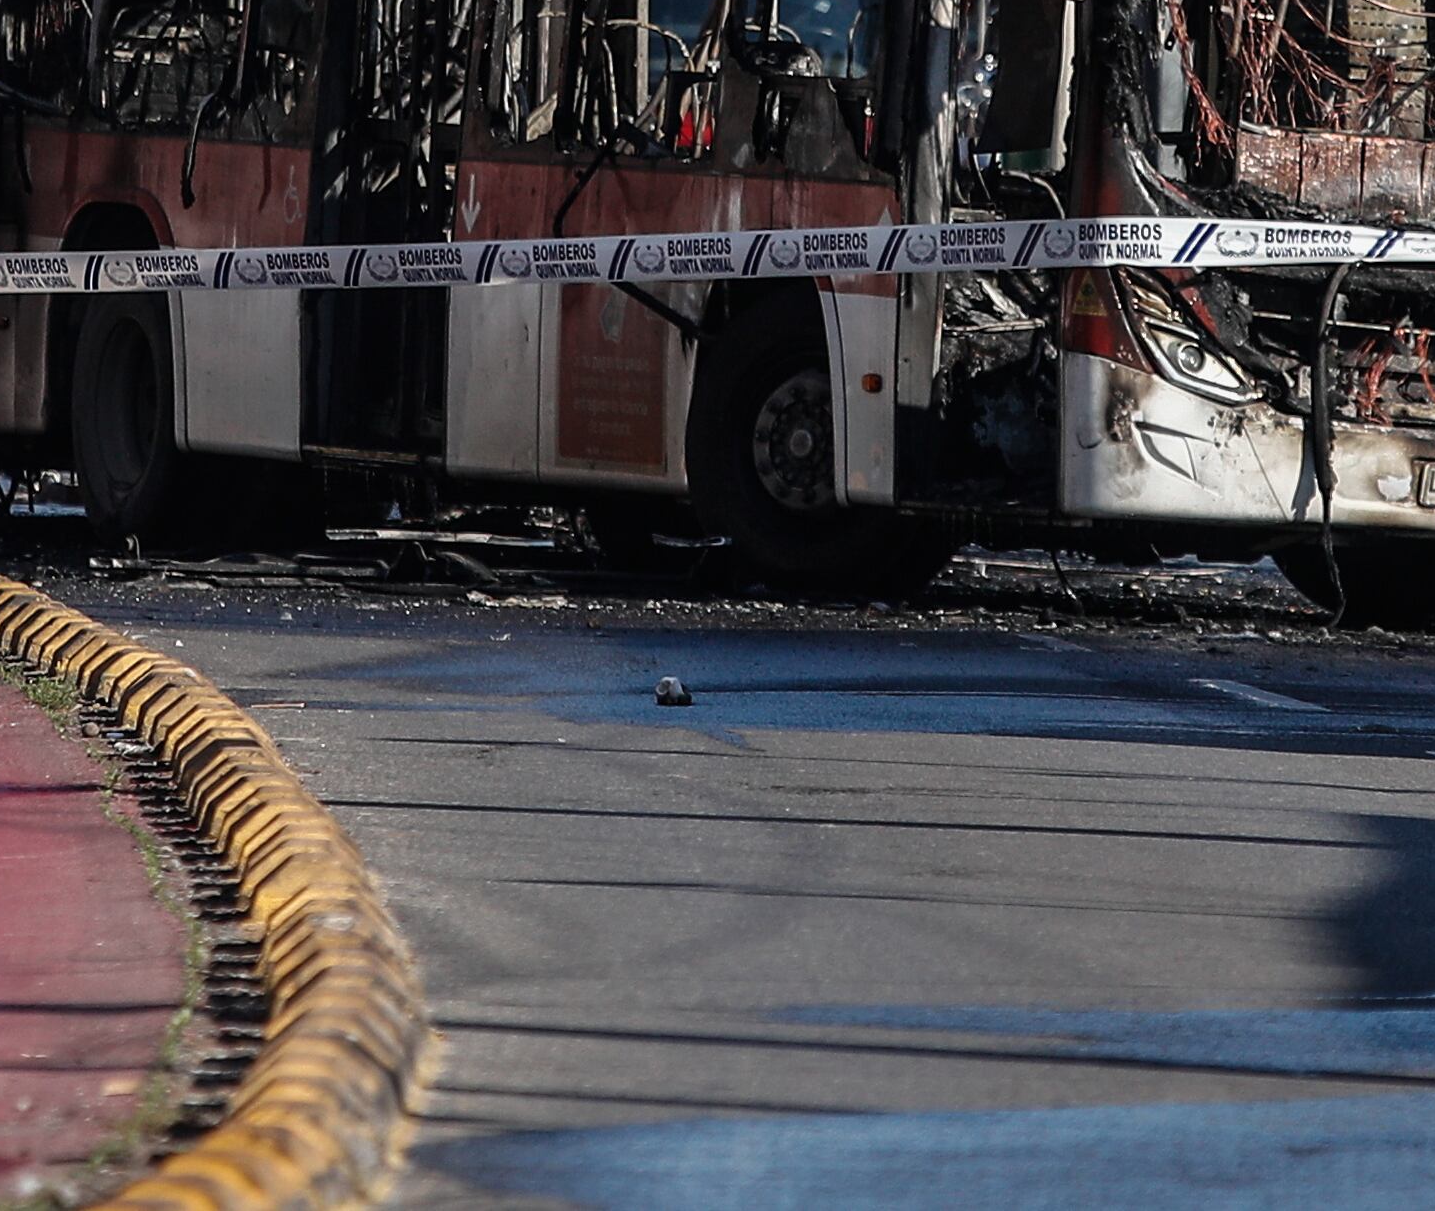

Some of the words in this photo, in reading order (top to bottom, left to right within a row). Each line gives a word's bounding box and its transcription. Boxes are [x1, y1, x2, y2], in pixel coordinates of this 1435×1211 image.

[941, 227, 1006, 246] BOMBEROS
[1079, 224, 1162, 240] BOMBEROS
[1265, 228, 1352, 244] BOMBEROS
[668, 238, 731, 256] BOMBEROS
[804, 233, 867, 251] BOMBEROS
[399, 248, 462, 266] BOMBEROS
[533, 243, 596, 262] BOMBEROS
[942, 249, 972, 265] QUINTA
[972, 247, 1006, 263] NORMAL
[1078, 244, 1115, 260] QUINTA
[1117, 244, 1162, 259] NORMAL
[1266, 246, 1308, 257] QUINTA
[1309, 247, 1356, 257] NORMAL
[6, 258, 68, 274] BOMBEROS
[136, 256, 198, 272] BOMBEROS
[267, 253, 329, 270] BOMBEROS
[670, 260, 700, 274] QUINTA
[700, 258, 734, 273] NORMAL
[805, 254, 836, 270] QUINTA
[836, 253, 870, 268] NORMAL
[403, 269, 432, 282] QUINTA
[433, 268, 468, 282] NORMAL
[536, 264, 565, 278] QUINTA
[566, 262, 600, 277] NORMAL
